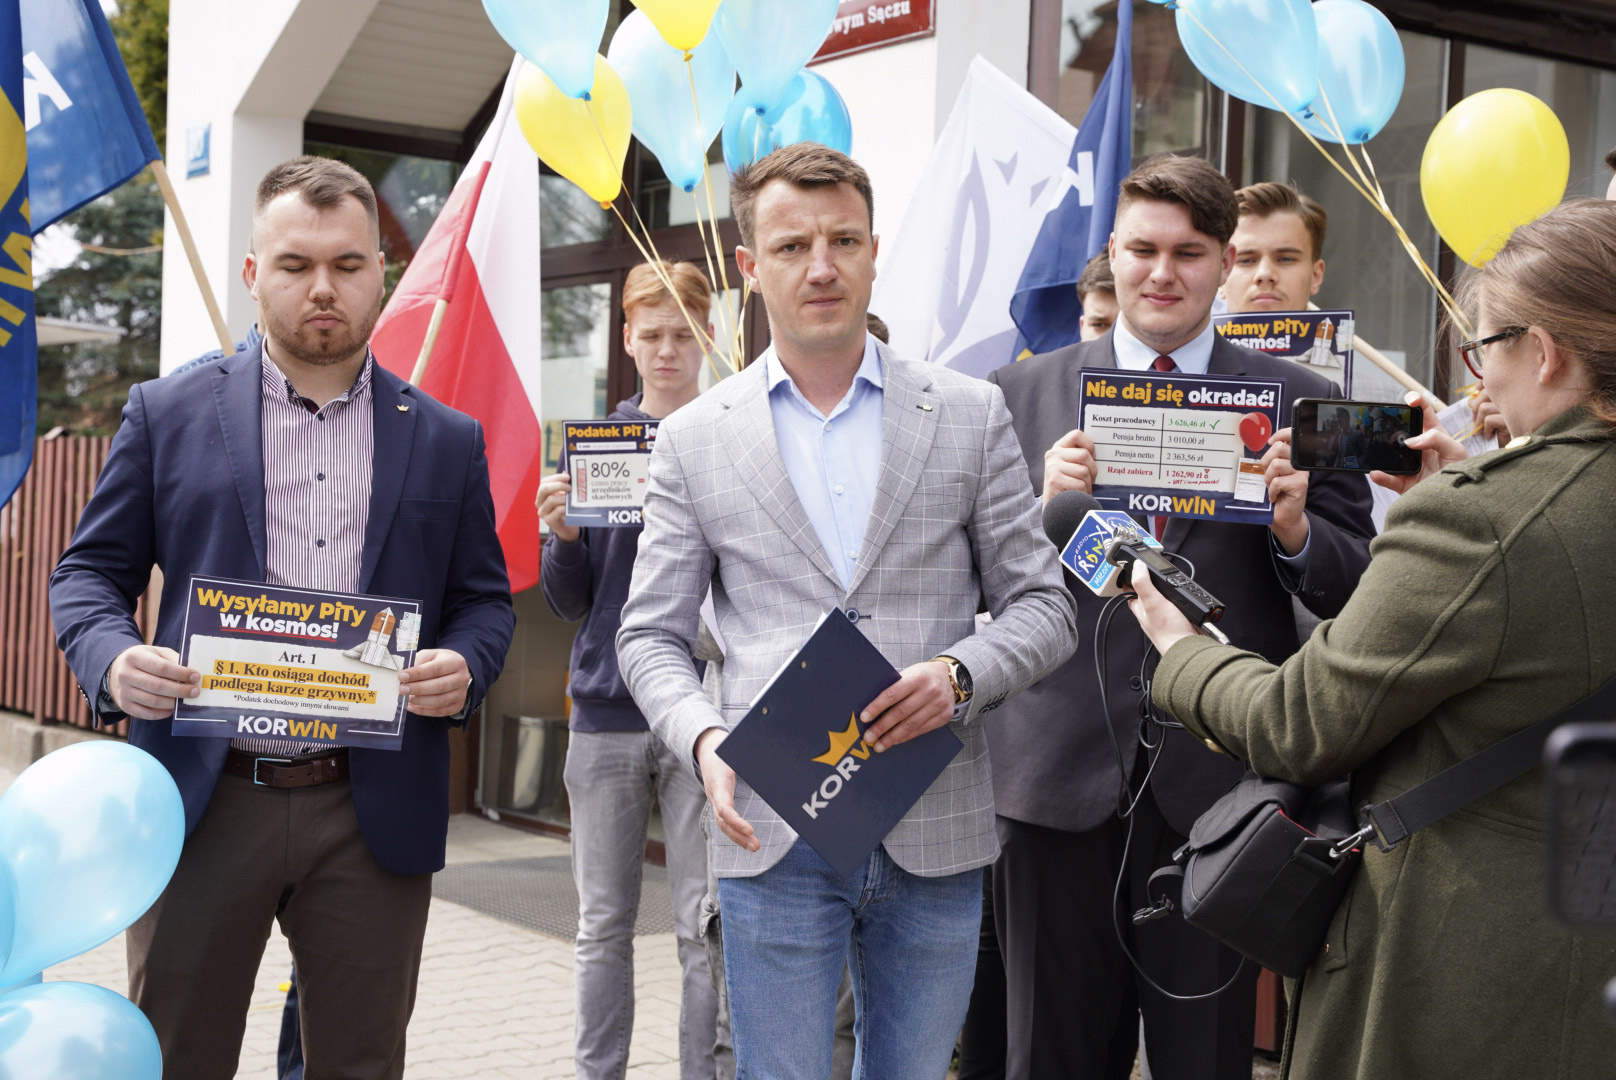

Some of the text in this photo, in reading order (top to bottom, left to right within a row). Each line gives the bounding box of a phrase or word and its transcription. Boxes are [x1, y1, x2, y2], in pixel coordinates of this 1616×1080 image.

[867, 1, 911, 24] Sączu
[1216, 318, 1310, 338] yłamy PiTy
[1227, 335, 1291, 349] osmos!
[1086, 379, 1275, 407] Nie daj się okradać!
[1092, 414, 1156, 427] Koszt pracodawcy
[1174, 419, 1198, 428] 626,46
[567, 424, 658, 439] Podatek PiT je
[1112, 432, 1155, 443] Pensja brutto
[1174, 436, 1197, 445] 010,00
[1198, 437, 1205, 445] zł
[1114, 449, 1154, 460] Pensja netto
[1197, 454, 1204, 462] zł
[590, 462, 631, 478] 80%
[1107, 466, 1153, 477] Rząd zabiera
[591, 486, 631, 494] urzędników
[591, 493, 633, 501] skarbowych
[1128, 493, 1216, 516] KORWIN
[608, 510, 645, 524] KOR
[1075, 536, 1089, 555] RADIO
[197, 587, 367, 627] Wysyłamy PiTy
[219, 613, 340, 639] w kosmos!
[278, 651, 316, 664] Art. 1
[216, 662, 370, 688] § 1. Kto osiąga dochód,
[209, 677, 261, 693] podlega
[267, 680, 304, 696] karze
[262, 697, 299, 707] dochodowy
[300, 701, 323, 710] innymi
[323, 702, 349, 711] słowami
[237, 713, 338, 740] KORWIN
[802, 739, 875, 820] KORW
